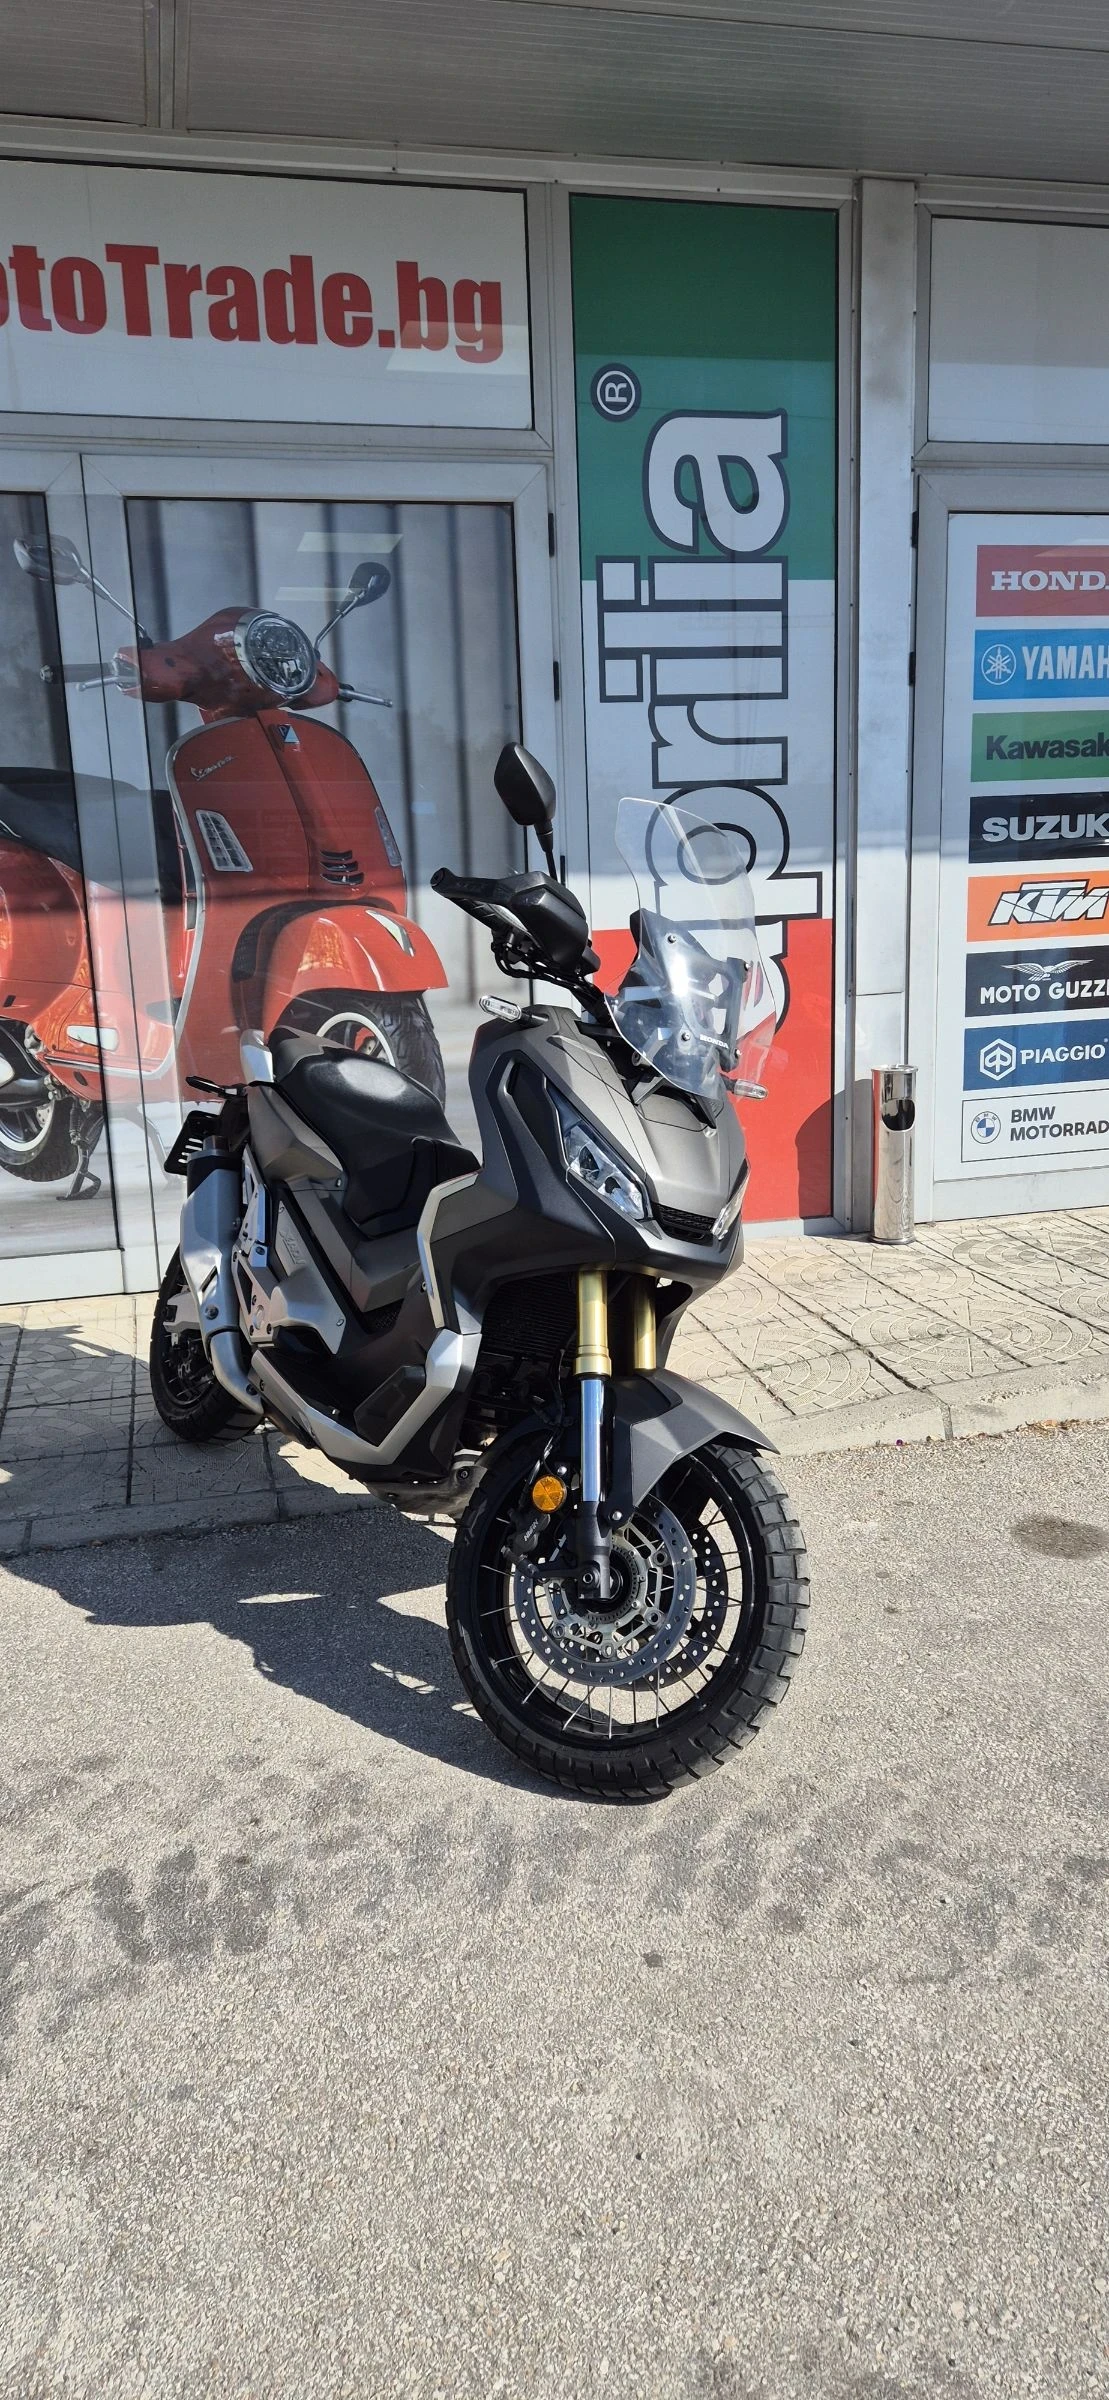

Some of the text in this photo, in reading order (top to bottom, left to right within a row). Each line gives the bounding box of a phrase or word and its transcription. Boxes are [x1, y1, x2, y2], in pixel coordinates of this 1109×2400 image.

[0, 244, 504, 364] toTrade.bg
[991, 570, 1109, 591] HOND
[988, 879, 1109, 926] KTM
[980, 983, 1041, 1005] MOTO
[699, 1033, 729, 1050] HONDA
[1020, 1044, 1106, 1065] PIAGGIO
[1010, 1105, 1056, 1123] BMW
[1010, 1120, 1109, 1141] MOTORRAD
